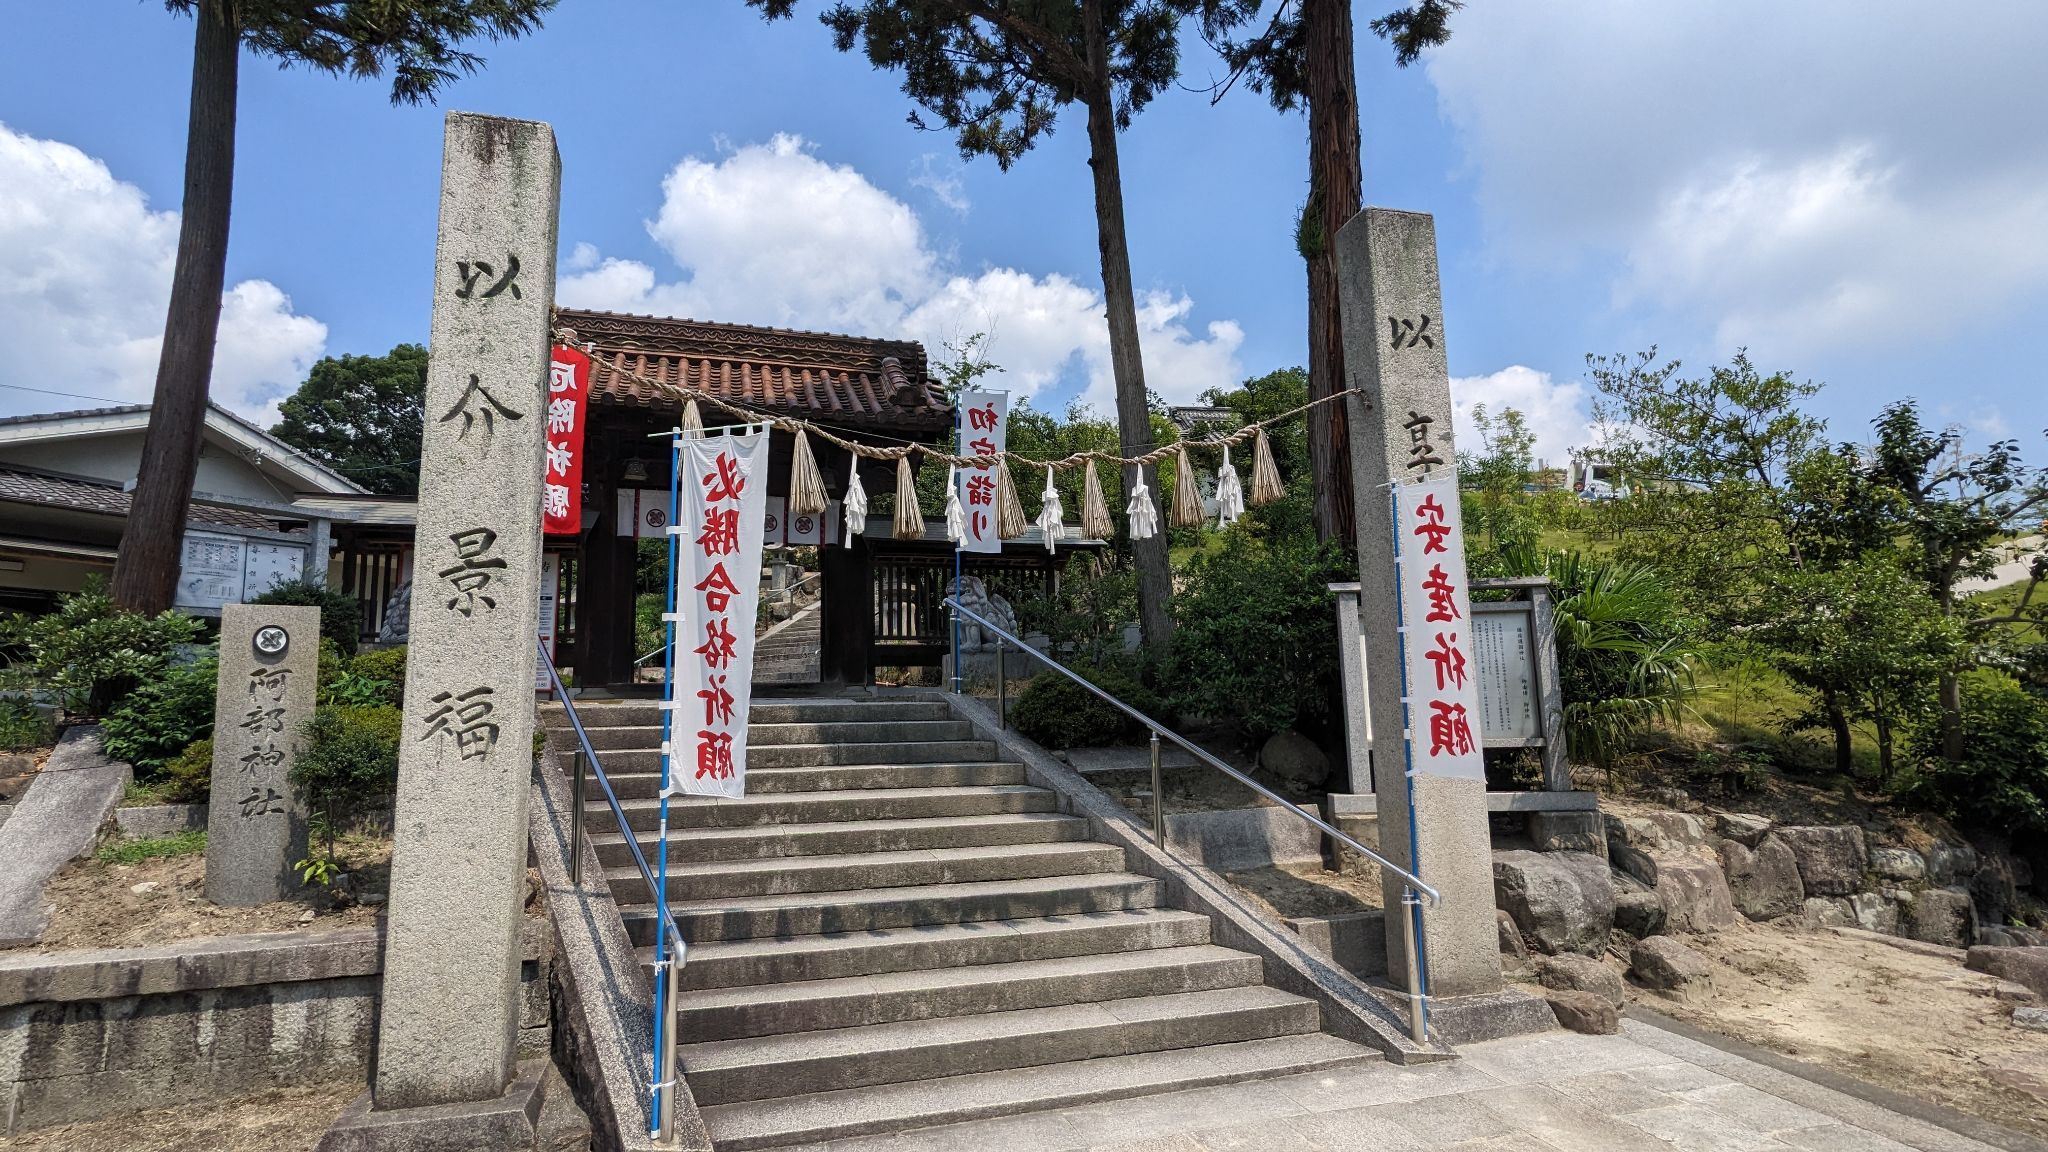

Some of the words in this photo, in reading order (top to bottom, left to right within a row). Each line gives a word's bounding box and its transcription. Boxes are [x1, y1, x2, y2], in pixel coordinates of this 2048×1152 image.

[419, 255, 524, 762] 以介景福
[238, 668, 293, 821] 阿部神社
